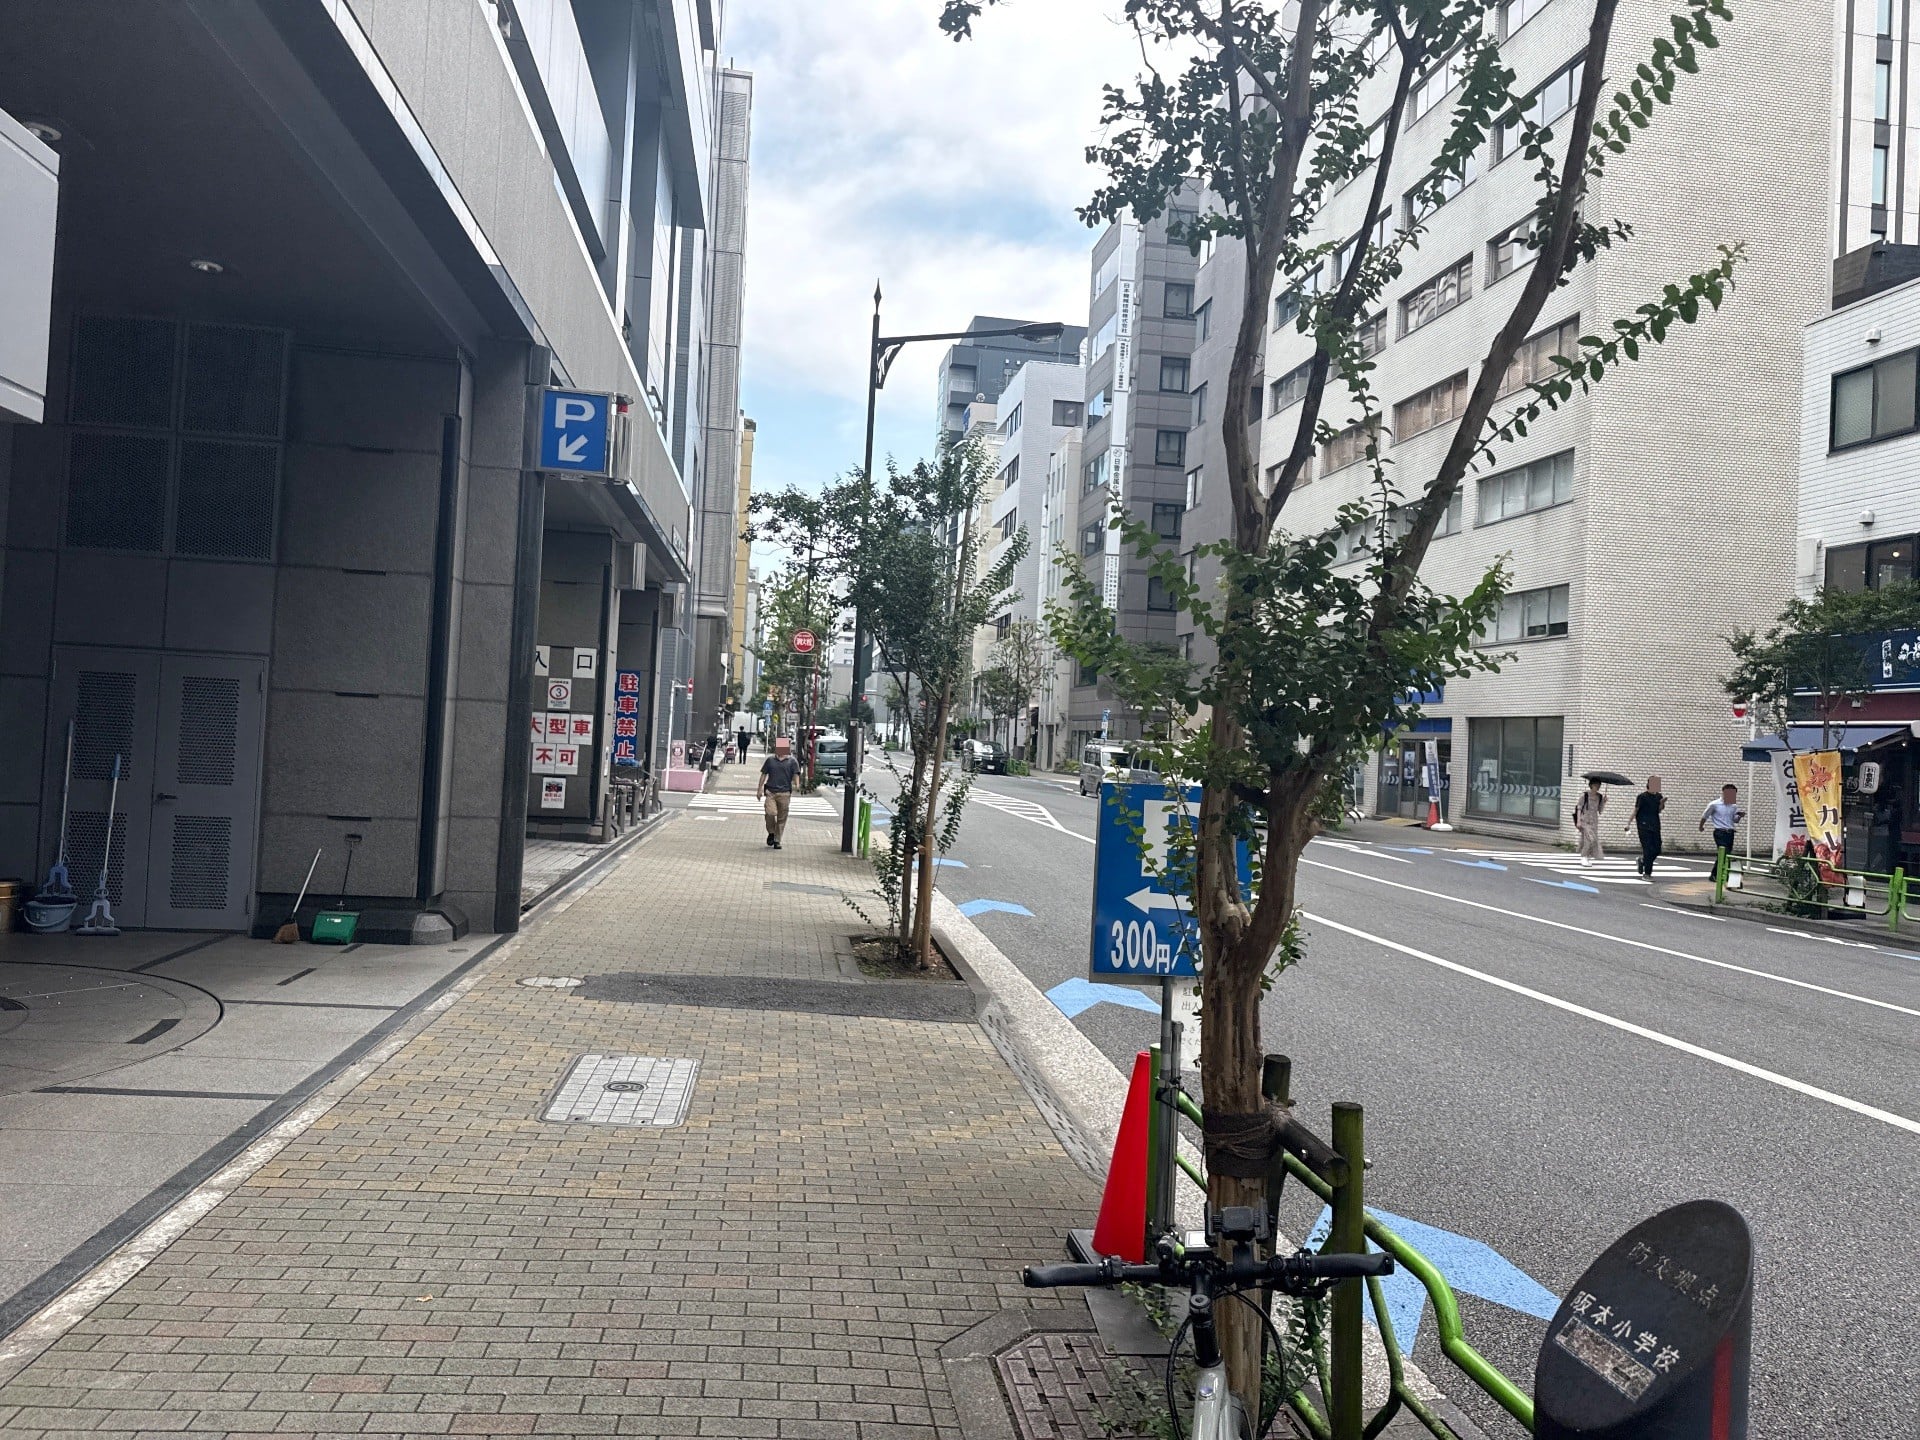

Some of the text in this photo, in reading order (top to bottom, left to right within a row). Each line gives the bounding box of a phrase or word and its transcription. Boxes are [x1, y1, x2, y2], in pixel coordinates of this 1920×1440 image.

[555, 398, 596, 428] P
[555, 687, 562, 698] 3
[532, 717, 591, 736] 大型車
[615, 673, 639, 759] 駐車禁止
[536, 748, 576, 765] 不可
[1570, 1290, 1681, 1374] 阪本小学校
